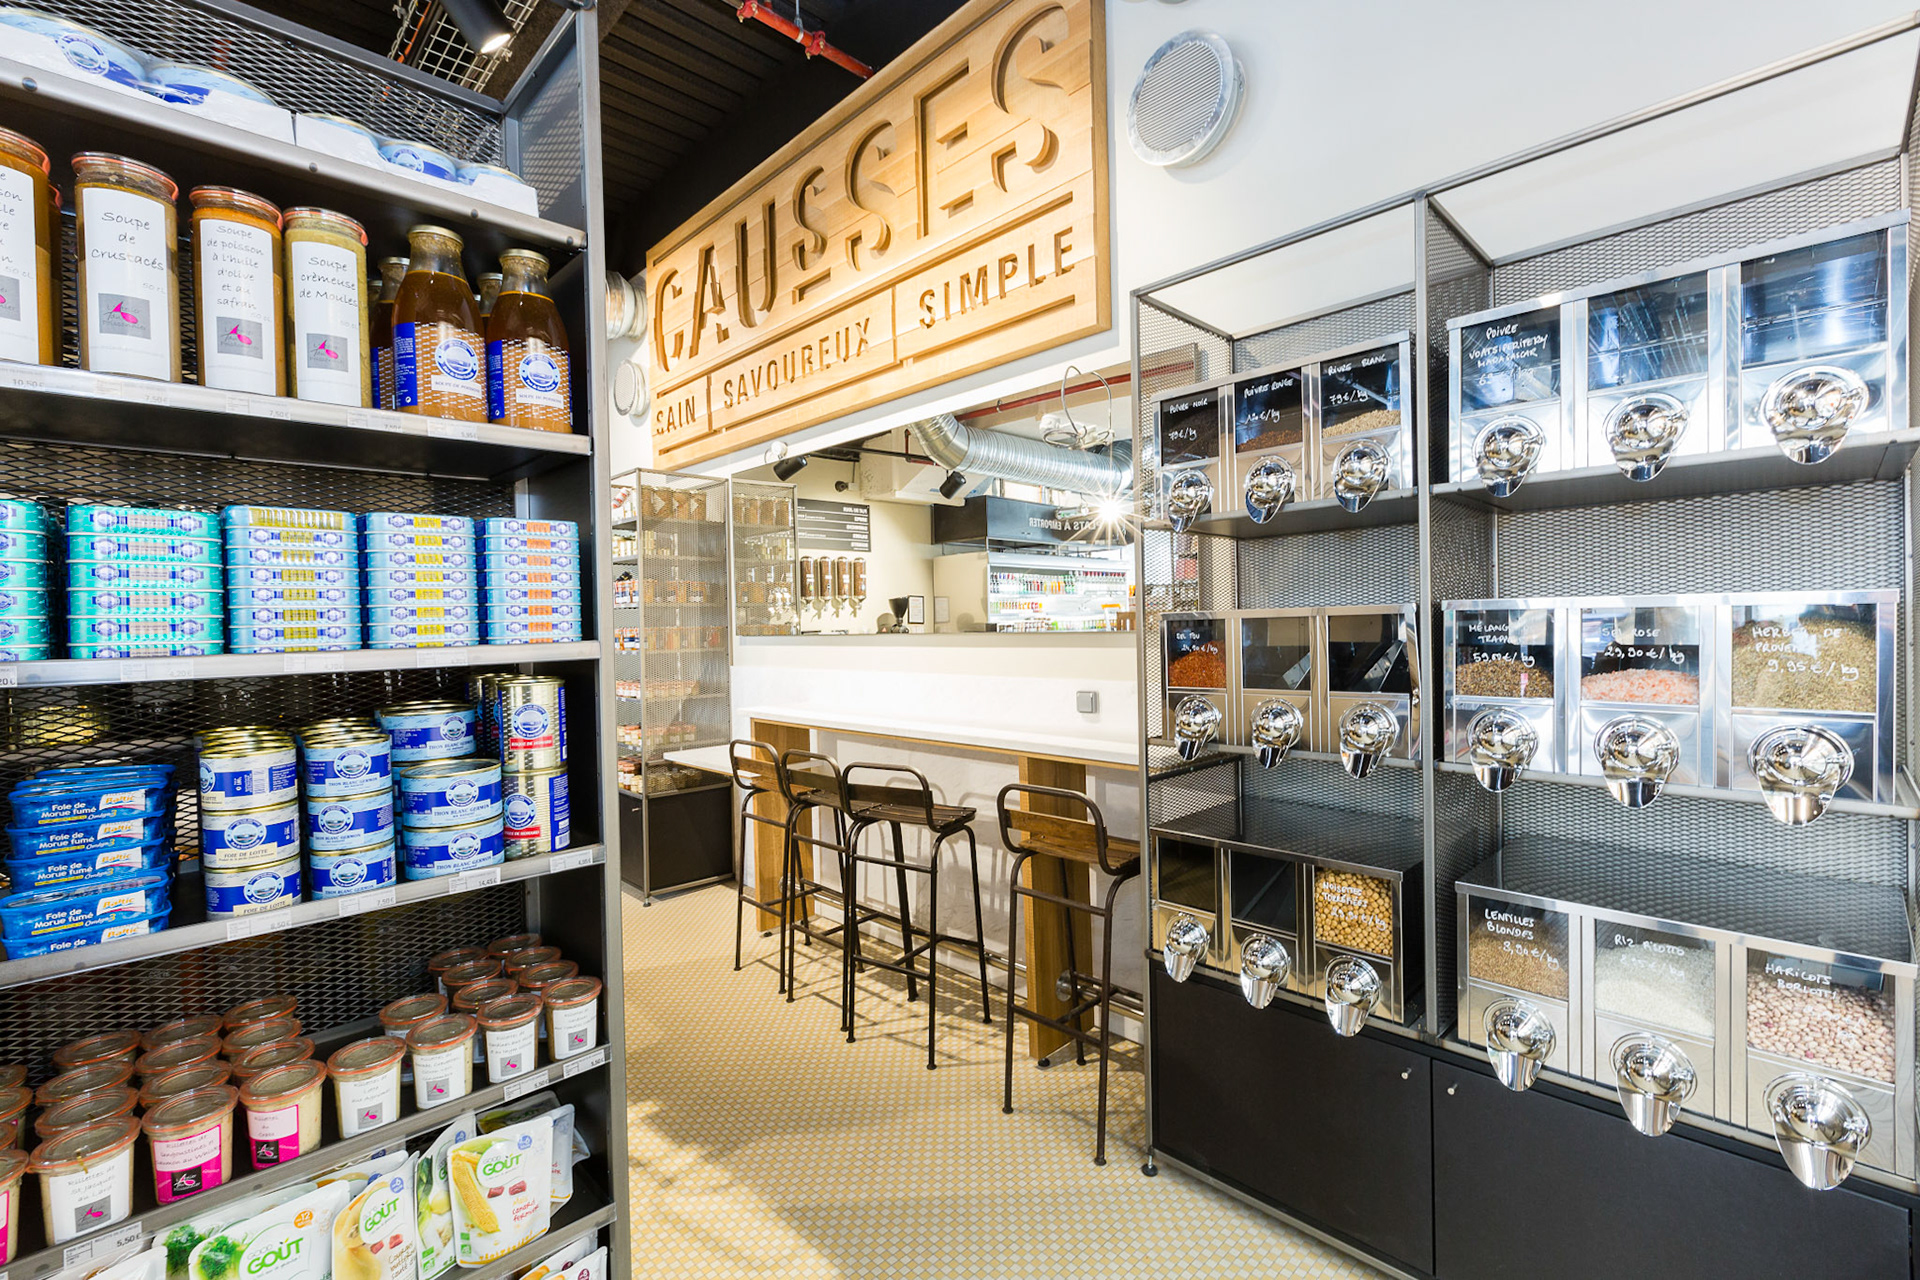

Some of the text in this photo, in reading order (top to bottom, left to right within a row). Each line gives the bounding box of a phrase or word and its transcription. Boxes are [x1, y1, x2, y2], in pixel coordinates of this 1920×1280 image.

[654, 2, 1070, 372] CAUSSES
[101, 211, 151, 231] Soupe
[118, 232, 136, 245] de
[216, 225, 253, 239] Soupe
[206, 238, 264, 256] de poisson
[308, 256, 348, 272] Soupe
[221, 283, 232, 292] et
[216, 297, 257, 310] safran
[299, 289, 359, 308] de Moules
[655, 225, 1074, 436] SAIN SAVOUREUX SIMPLE
[105, 794, 135, 804] Baltic
[41, 806, 97, 819] Morue fumé
[51, 803, 73, 812] Foie
[103, 825, 132, 833] Baltic
[39, 836, 95, 849] Morue fumé
[49, 833, 71, 842] Foie
[101, 853, 131, 863] Baltic
[37, 866, 93, 880] Morue fumé
[48, 864, 68, 873] Foie
[102, 897, 135, 908] Baltic
[34, 913, 94, 929] Morue fumé
[45, 908, 82, 921] Foie de
[107, 926, 139, 938] Baltic
[1486, 920, 1534, 940] BLONDES
[50, 938, 87, 951] Foie de
